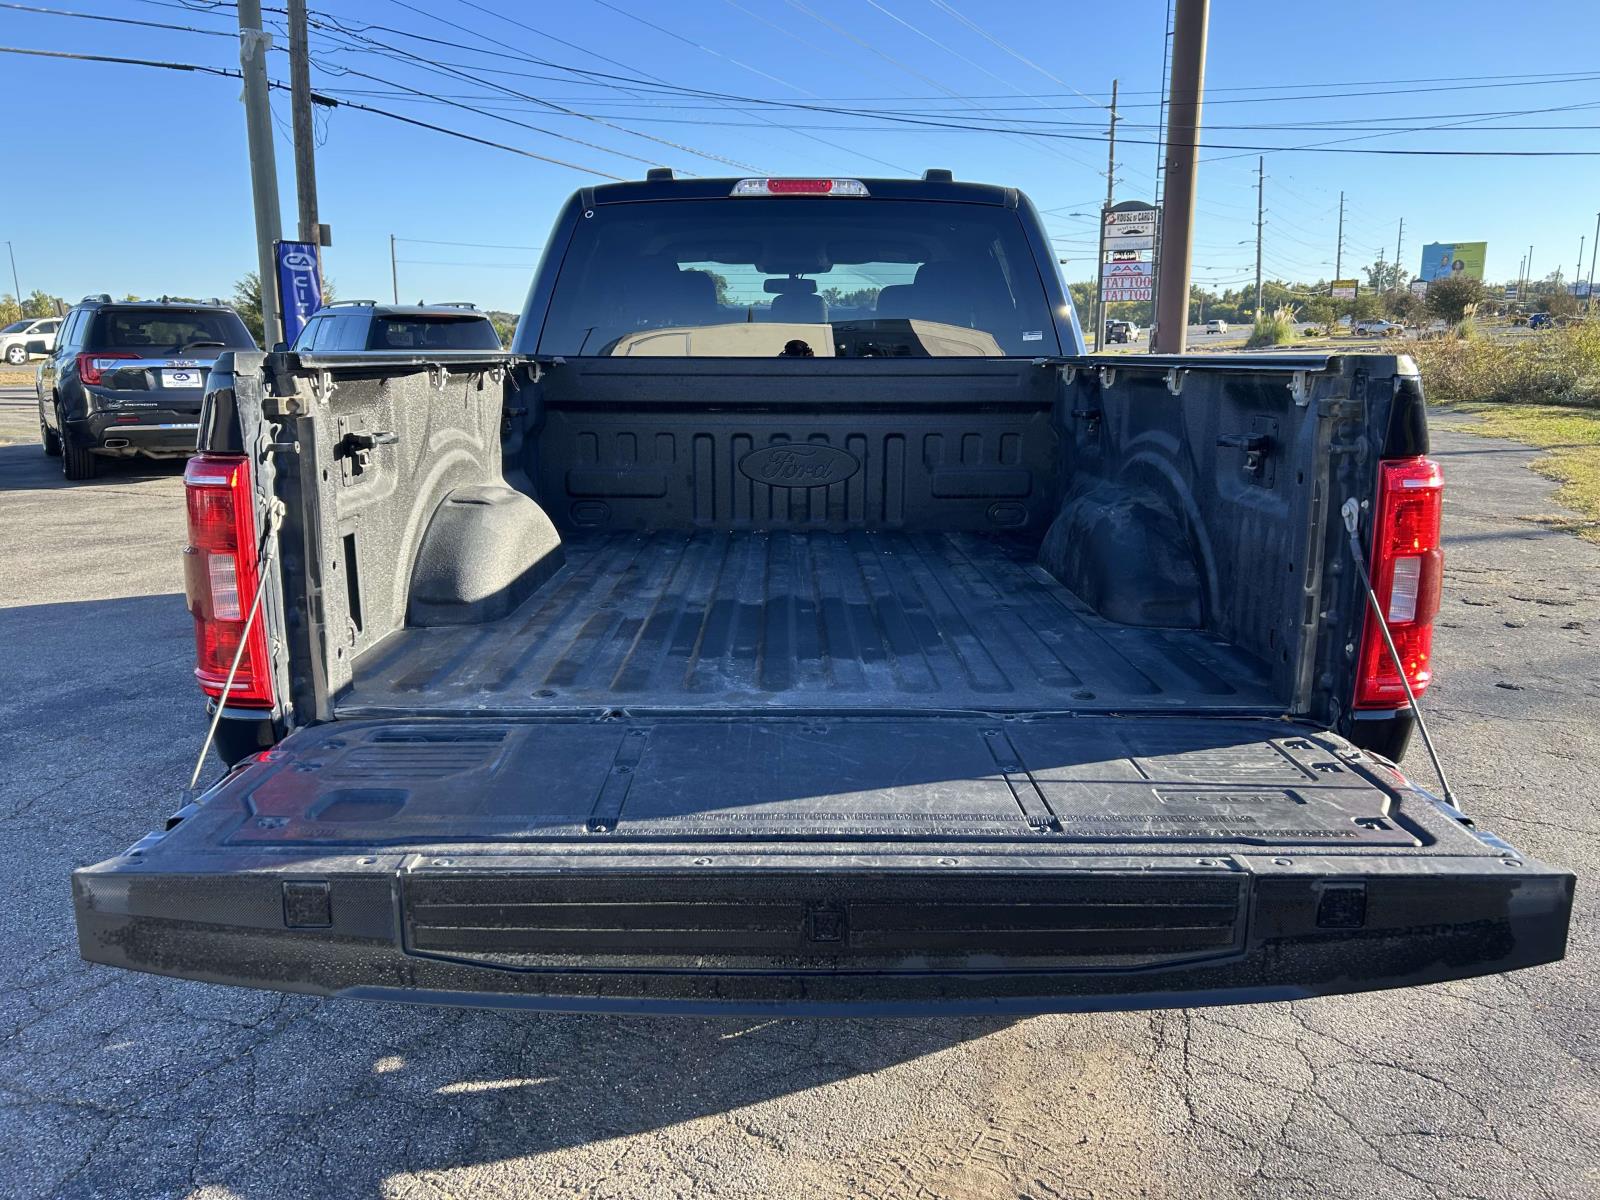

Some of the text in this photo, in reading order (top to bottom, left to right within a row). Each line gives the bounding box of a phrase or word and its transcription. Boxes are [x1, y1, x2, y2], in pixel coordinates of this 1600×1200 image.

[1116, 213, 1133, 222] HOUSE
[1103, 276, 1152, 288] TATTOO
[1103, 289, 1150, 301] TATTOO
[760, 450, 834, 479] Ford
